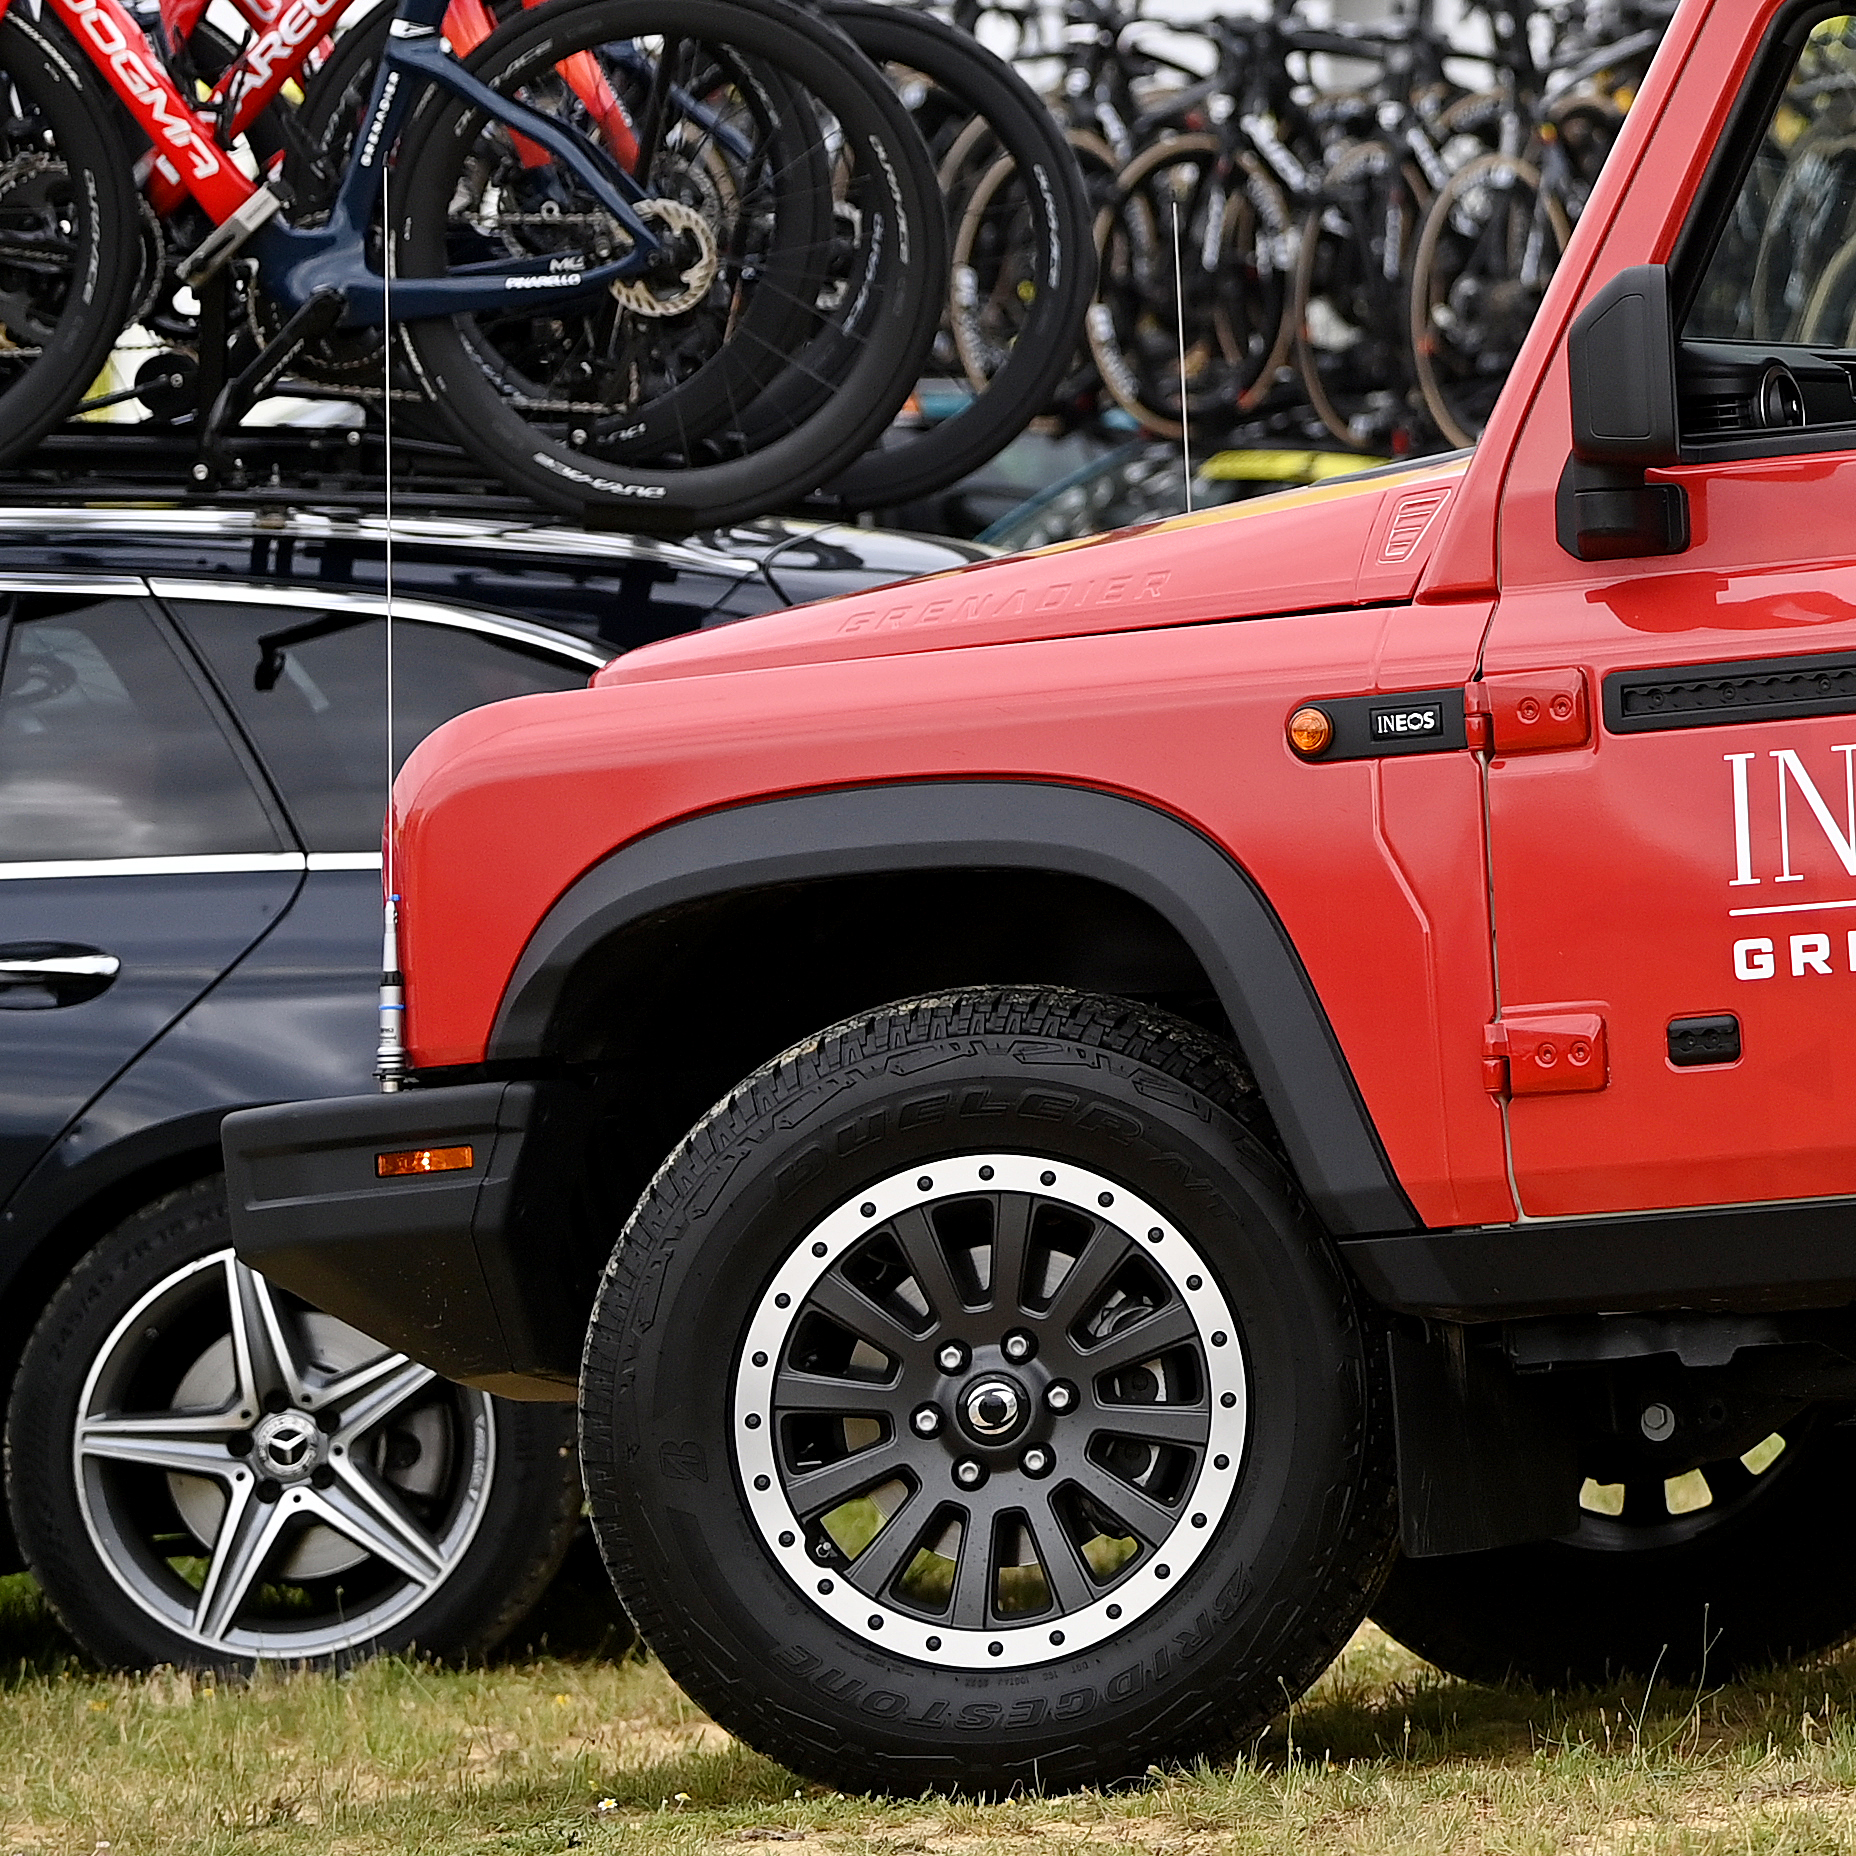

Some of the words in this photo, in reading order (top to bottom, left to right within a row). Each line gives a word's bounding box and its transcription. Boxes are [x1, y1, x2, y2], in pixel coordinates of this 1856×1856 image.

[1376, 708, 1437, 733] INEOS
[772, 1084, 1150, 1205] DUELER
[772, 1560, 1261, 1734] BRIDGESTONE
